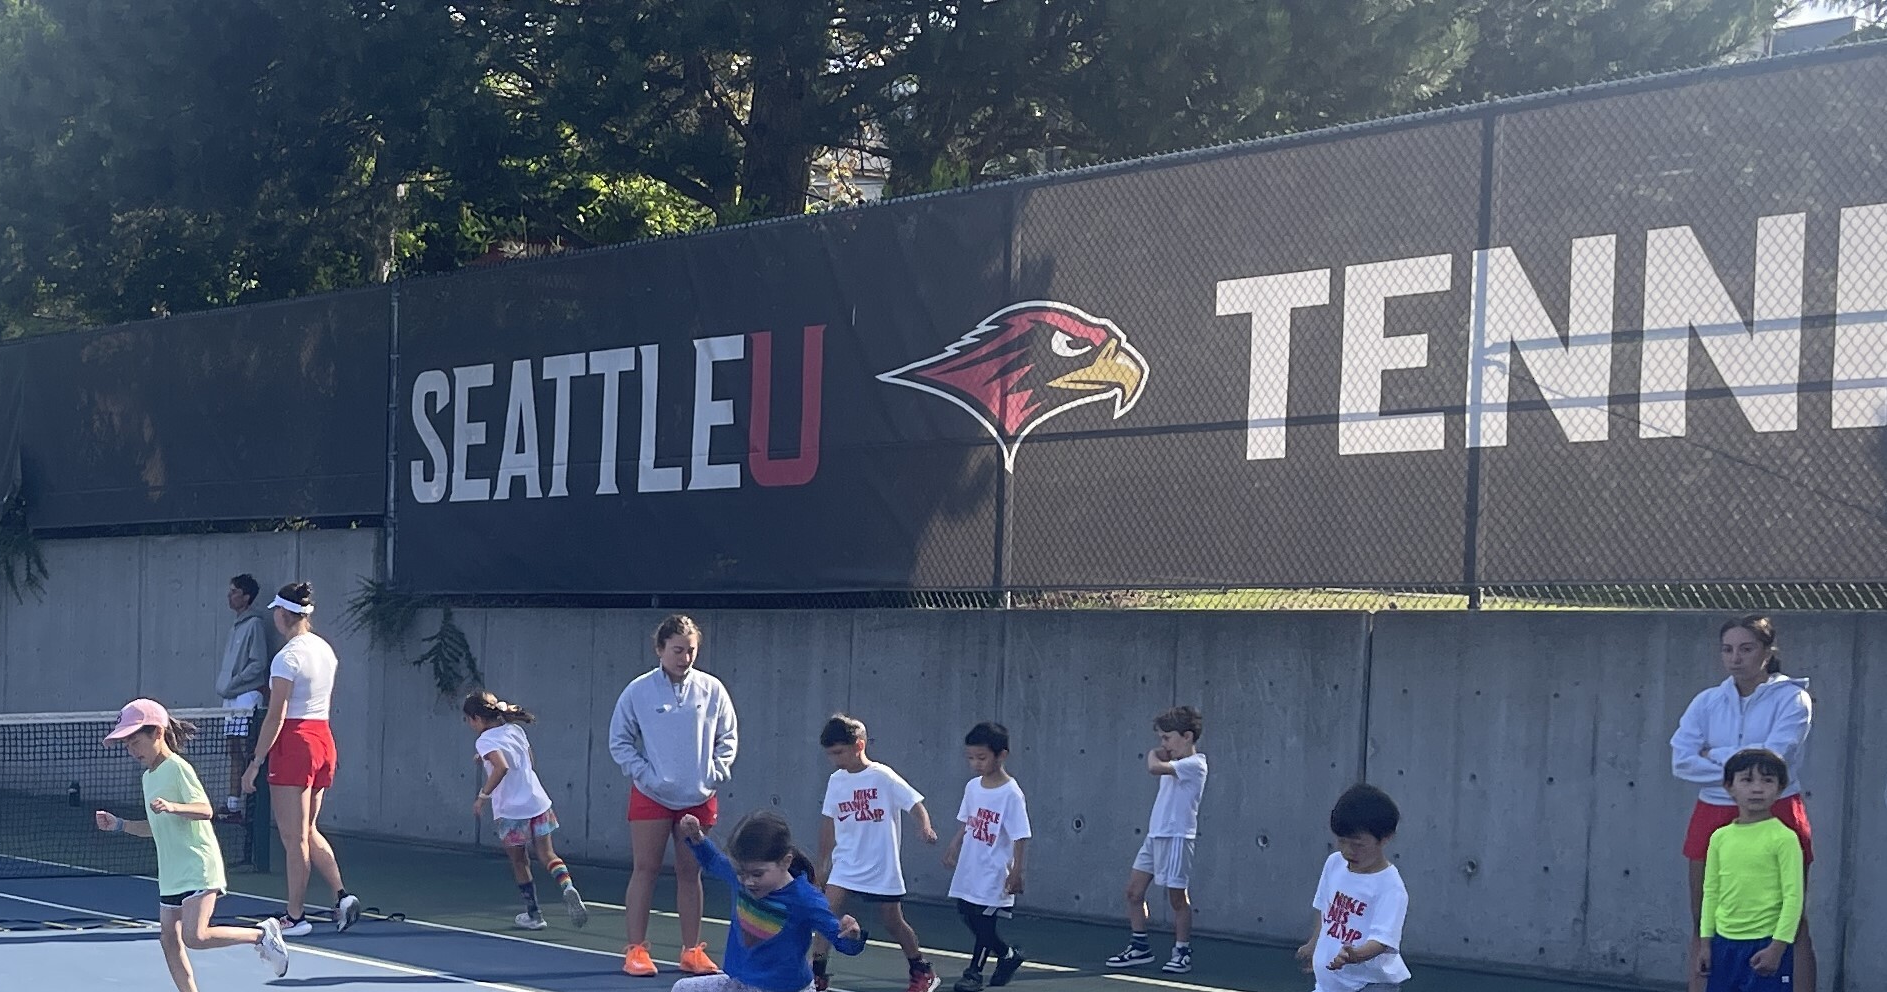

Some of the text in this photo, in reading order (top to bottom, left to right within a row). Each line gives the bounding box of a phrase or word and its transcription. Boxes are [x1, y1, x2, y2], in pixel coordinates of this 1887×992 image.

[1216, 203, 1887, 460] TENNI
[853, 788, 878, 800] NIKE
[854, 808, 885, 821] CAMP
[1333, 891, 1368, 916] NIKE
[1327, 921, 1363, 942] AMP
